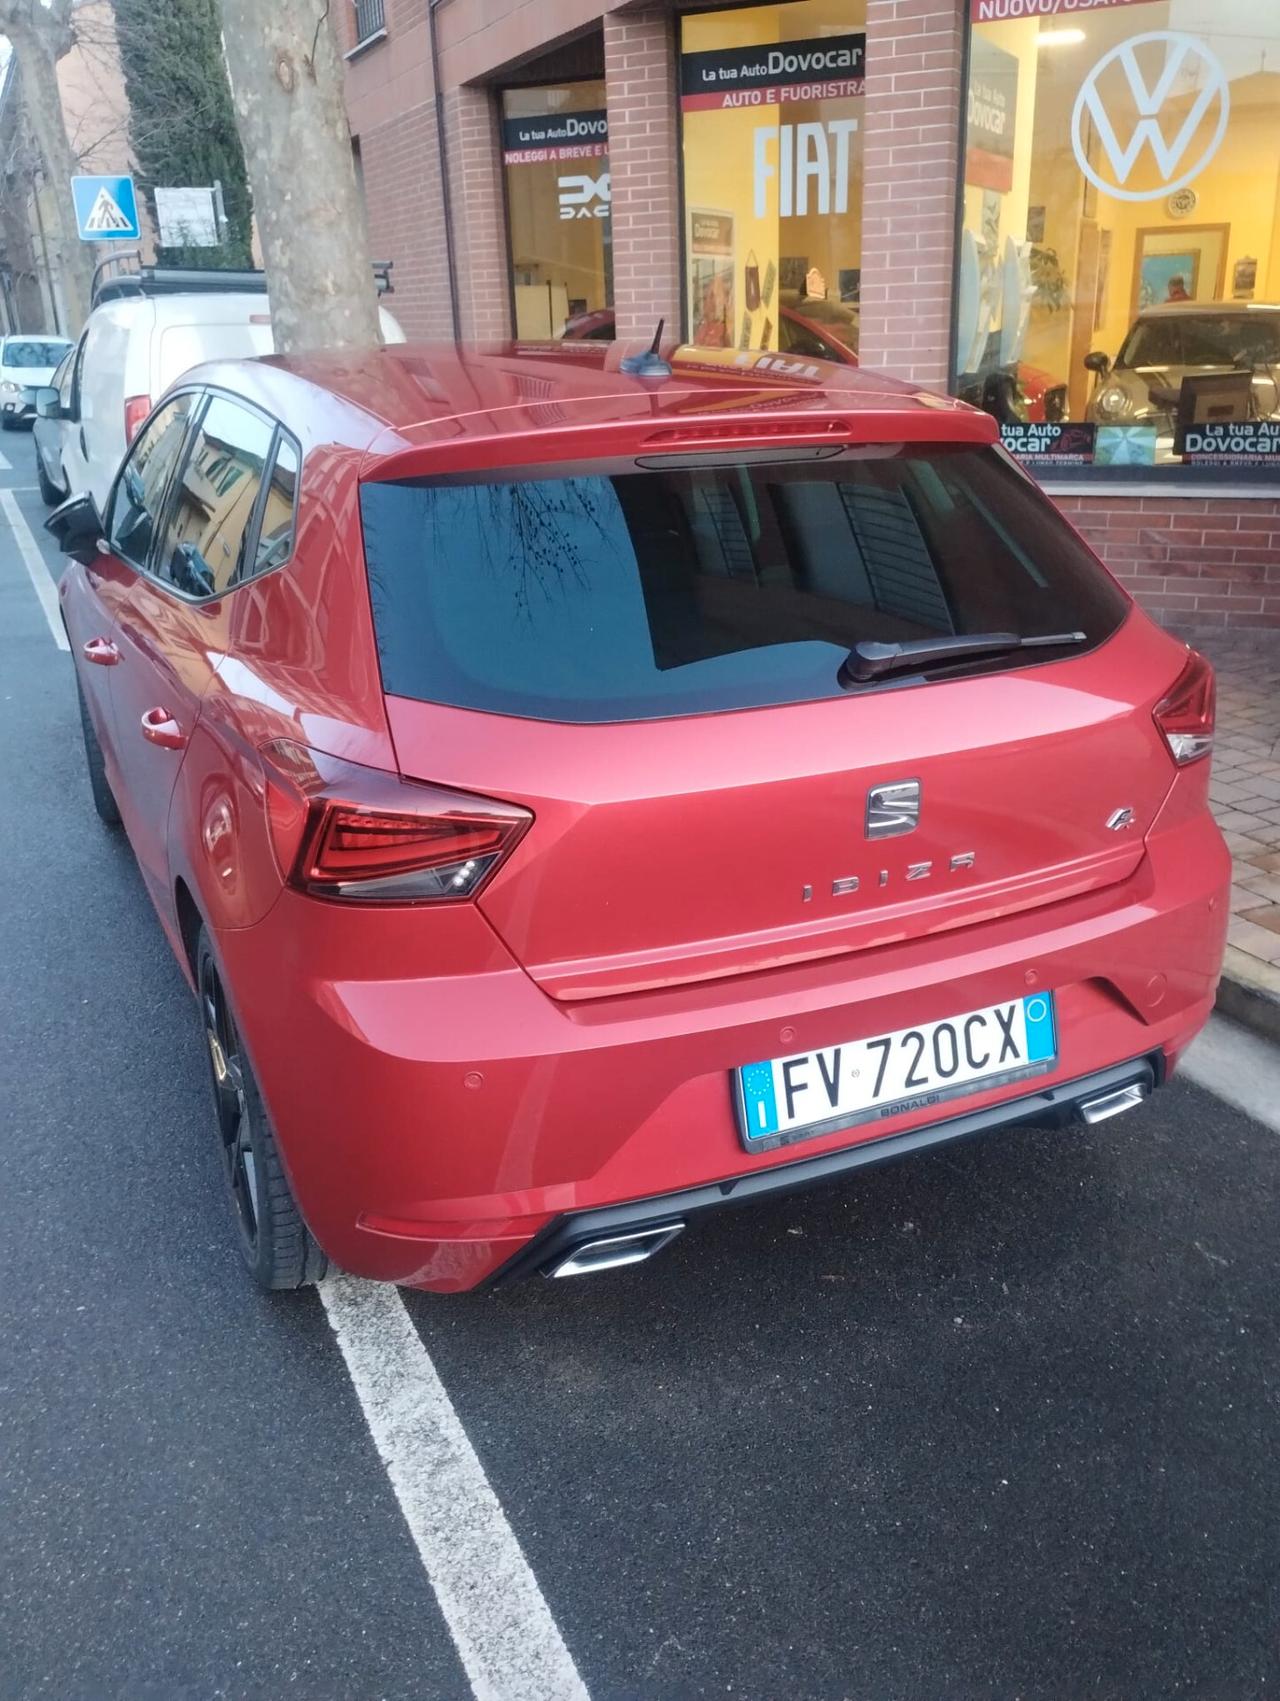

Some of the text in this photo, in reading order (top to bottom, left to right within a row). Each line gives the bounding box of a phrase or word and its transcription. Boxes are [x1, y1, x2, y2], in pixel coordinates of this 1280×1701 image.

[979, 0, 1132, 19] NUOVO/
[702, 48, 862, 81] La tua Auto Dovocar
[722, 80, 866, 107] AUTO E FUORISTRA
[519, 131, 530, 141] La
[531, 131, 546, 140] tua
[547, 128, 567, 139] Auto
[505, 150, 548, 164] NOLEGGI
[549, 149, 557, 160] A
[559, 146, 592, 159] BREVE
[594, 145, 602, 156] E
[754, 119, 858, 219] FIAT
[1001, 423, 1061, 436] tua Auto
[1206, 423, 1223, 436] La
[1229, 422, 1254, 436] tua
[1000, 437, 1050, 452] ocar
[1185, 433, 1280, 452] Dovocar
[803, 851, 975, 903] IBIZA
[782, 1004, 1021, 1119] FV 720CX
[880, 1095, 941, 1117] BONALDI
